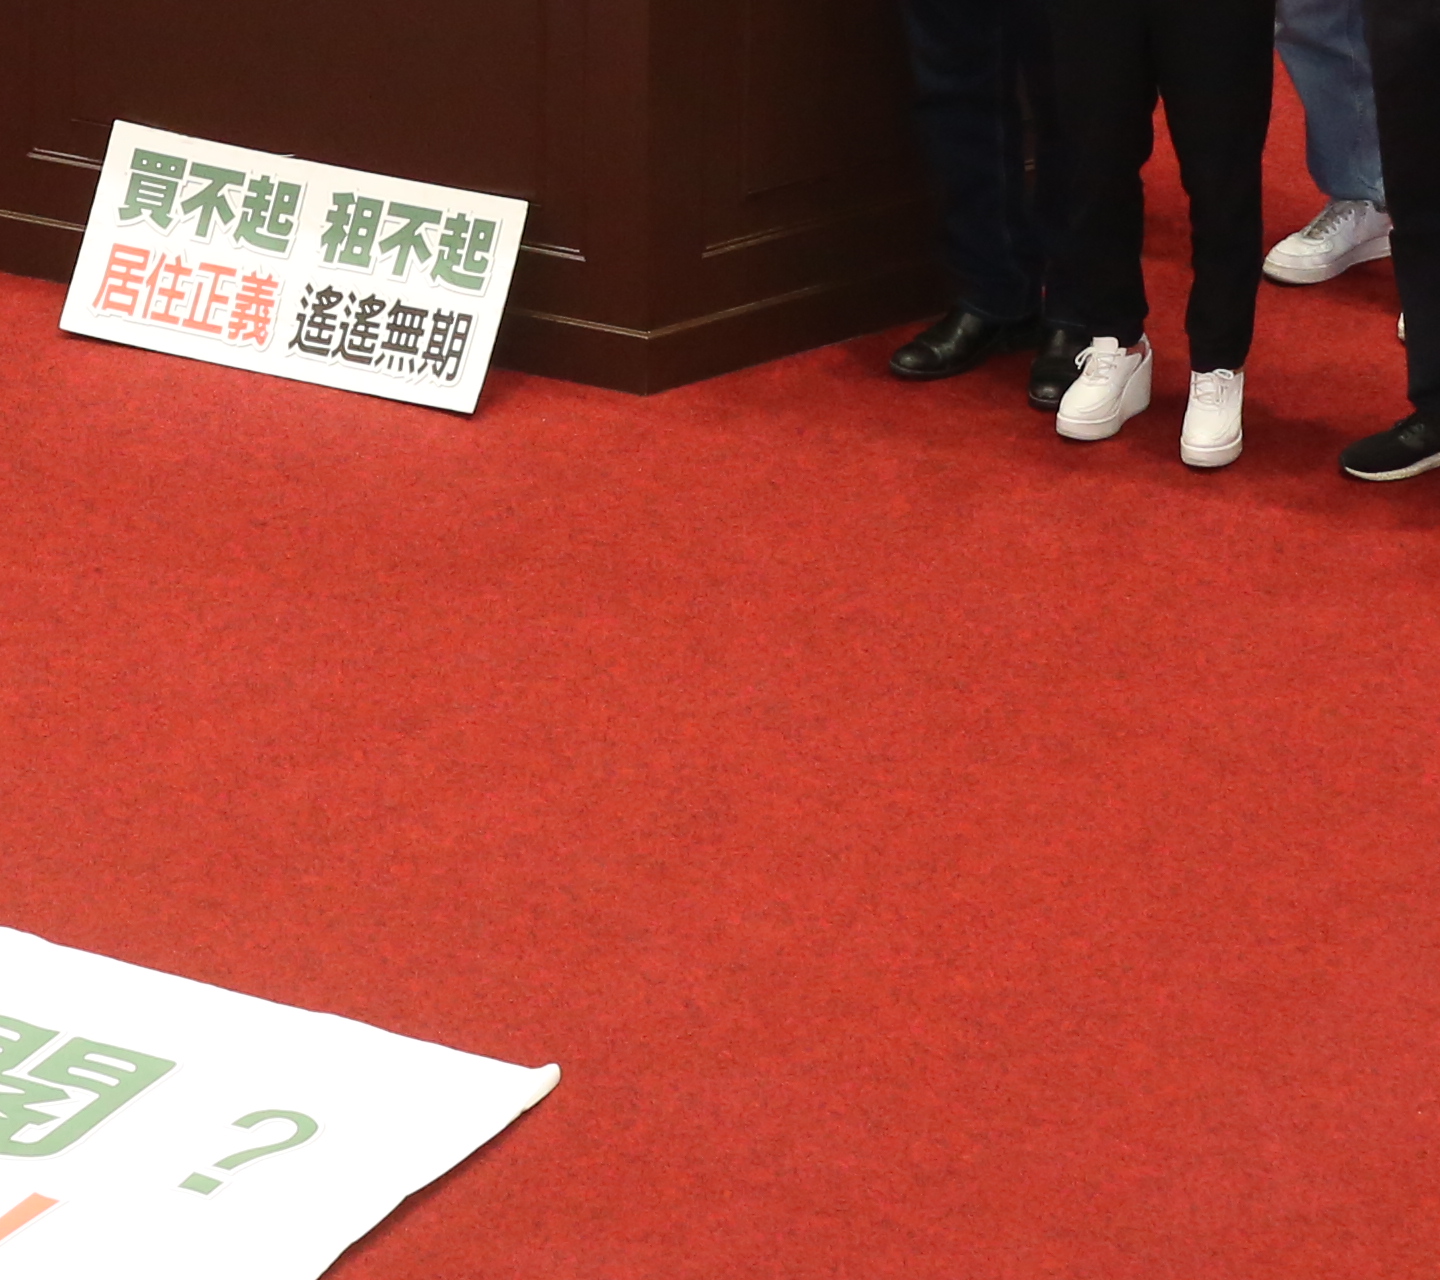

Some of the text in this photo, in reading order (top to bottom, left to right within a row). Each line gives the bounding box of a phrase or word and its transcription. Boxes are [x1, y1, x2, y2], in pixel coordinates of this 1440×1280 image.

[118, 147, 498, 292] 買不起 租不起
[93, 243, 474, 382] 居住正義 遙遙無期
